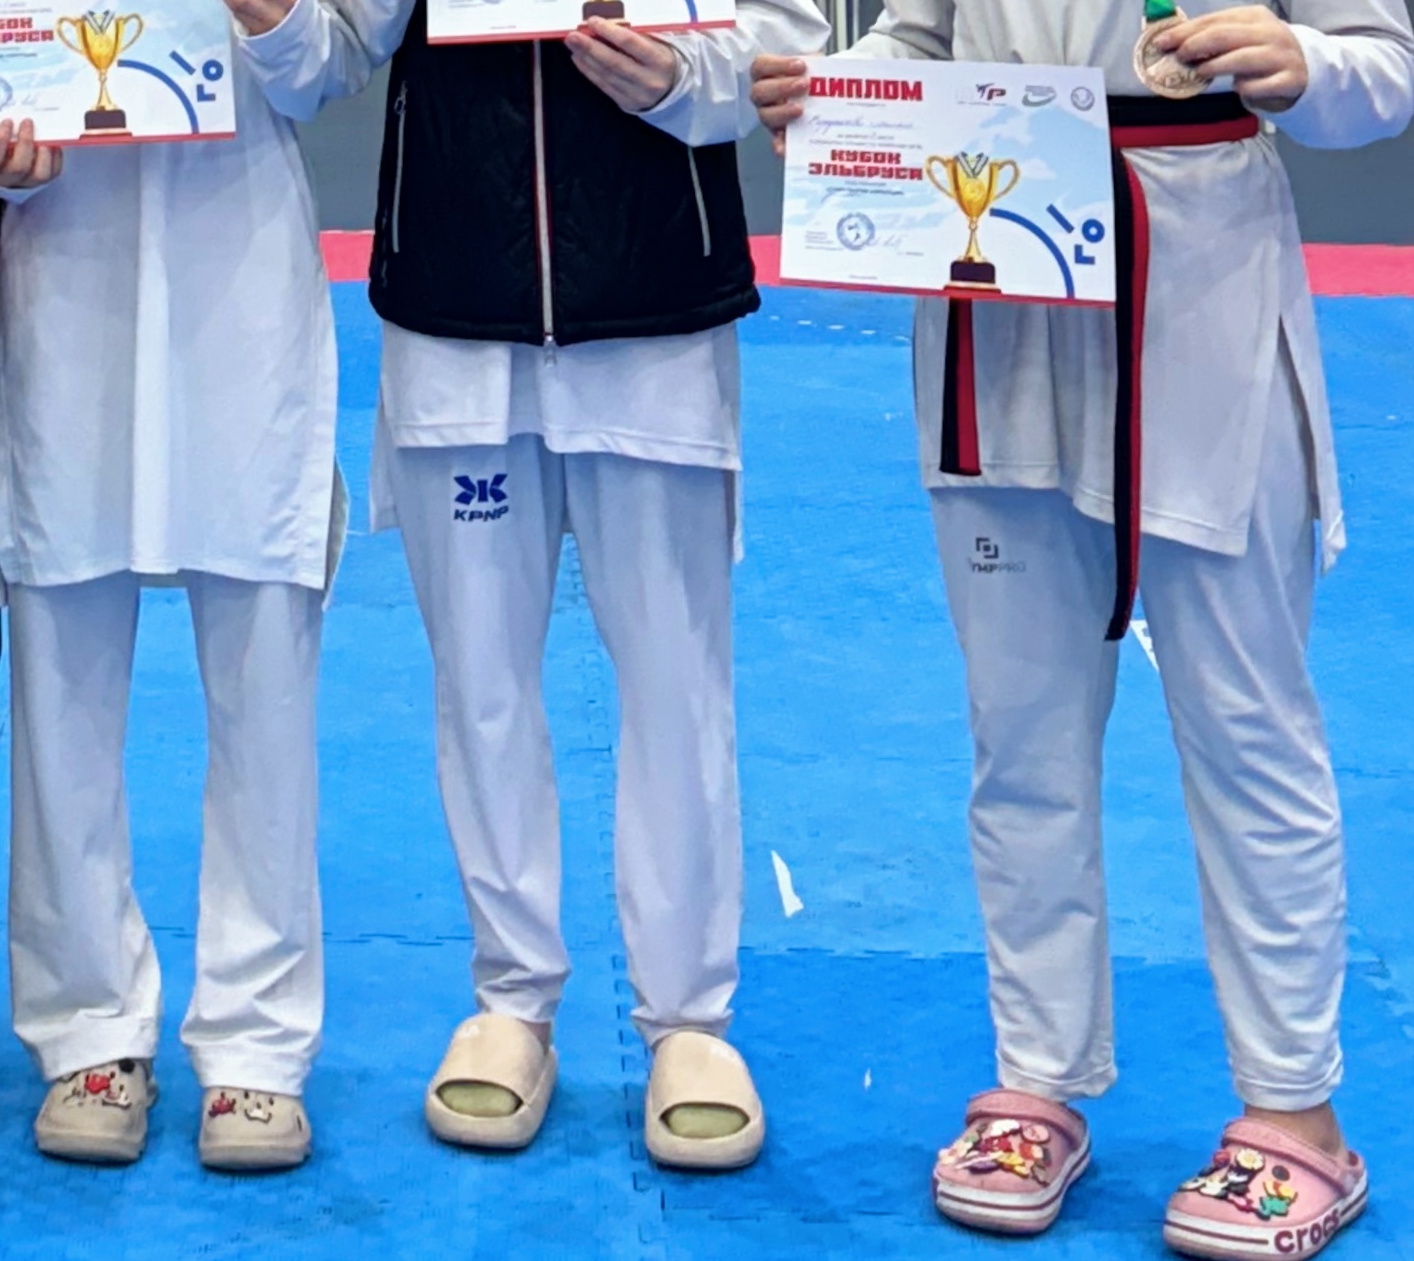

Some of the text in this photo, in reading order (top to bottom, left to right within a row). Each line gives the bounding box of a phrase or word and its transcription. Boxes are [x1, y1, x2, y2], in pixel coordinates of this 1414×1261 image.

[808, 76, 923, 102] ДИПЛОМ
[831, 149, 902, 165] КУБОК
[808, 162, 923, 181] ЭЛЬБРУСА
[453, 504, 510, 523] KPNP
[1274, 1208, 1340, 1254] crocs
